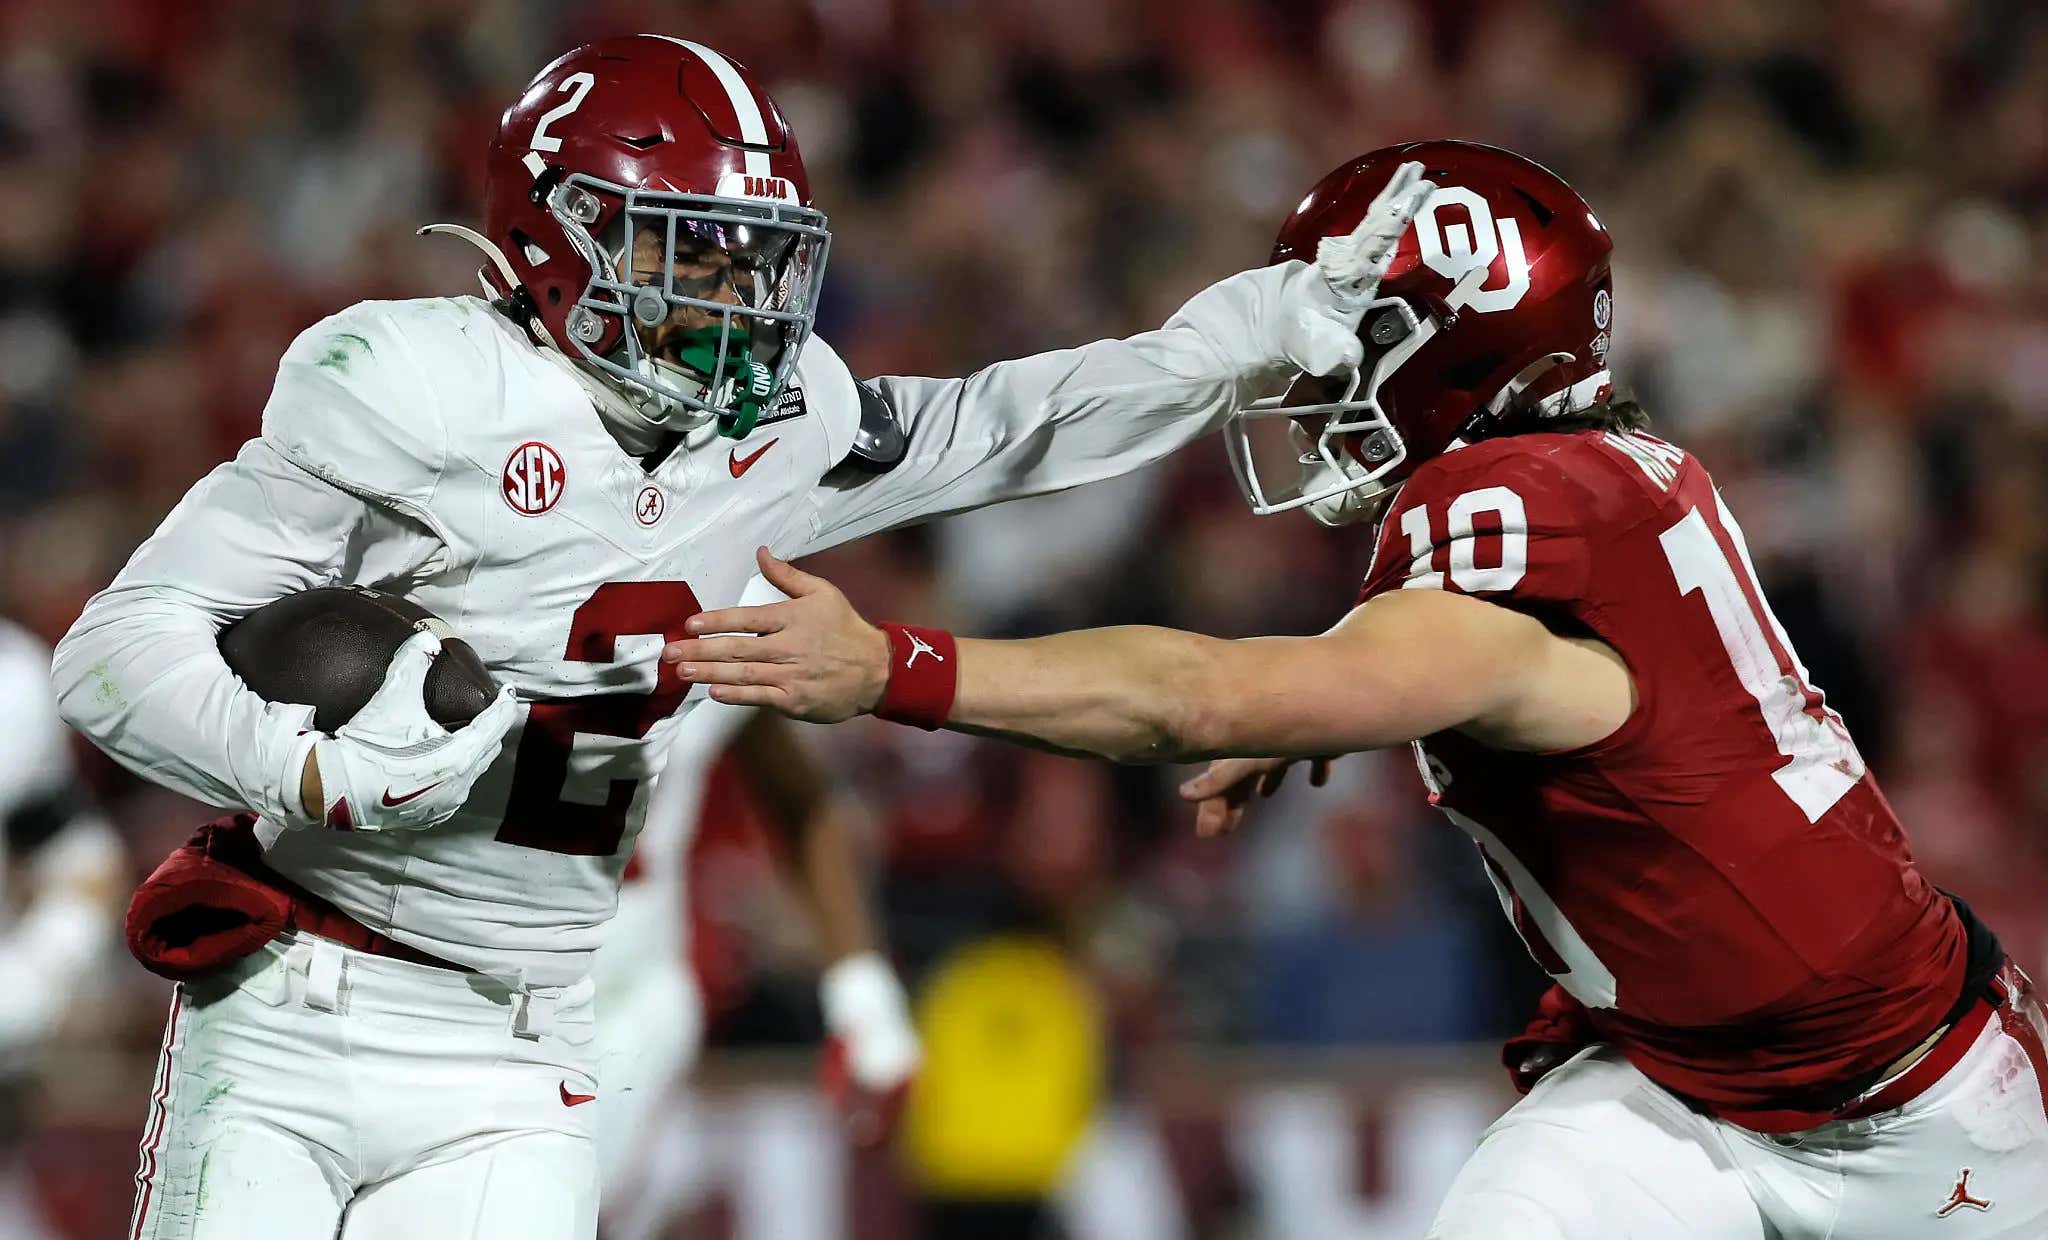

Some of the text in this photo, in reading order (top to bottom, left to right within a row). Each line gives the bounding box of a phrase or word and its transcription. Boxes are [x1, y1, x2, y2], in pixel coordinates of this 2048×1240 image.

[530, 71, 594, 152] 2
[744, 176, 787, 199] BAMA
[506, 446, 561, 511] SEC
[1401, 486, 1528, 592] 10
[494, 580, 703, 856] 2
